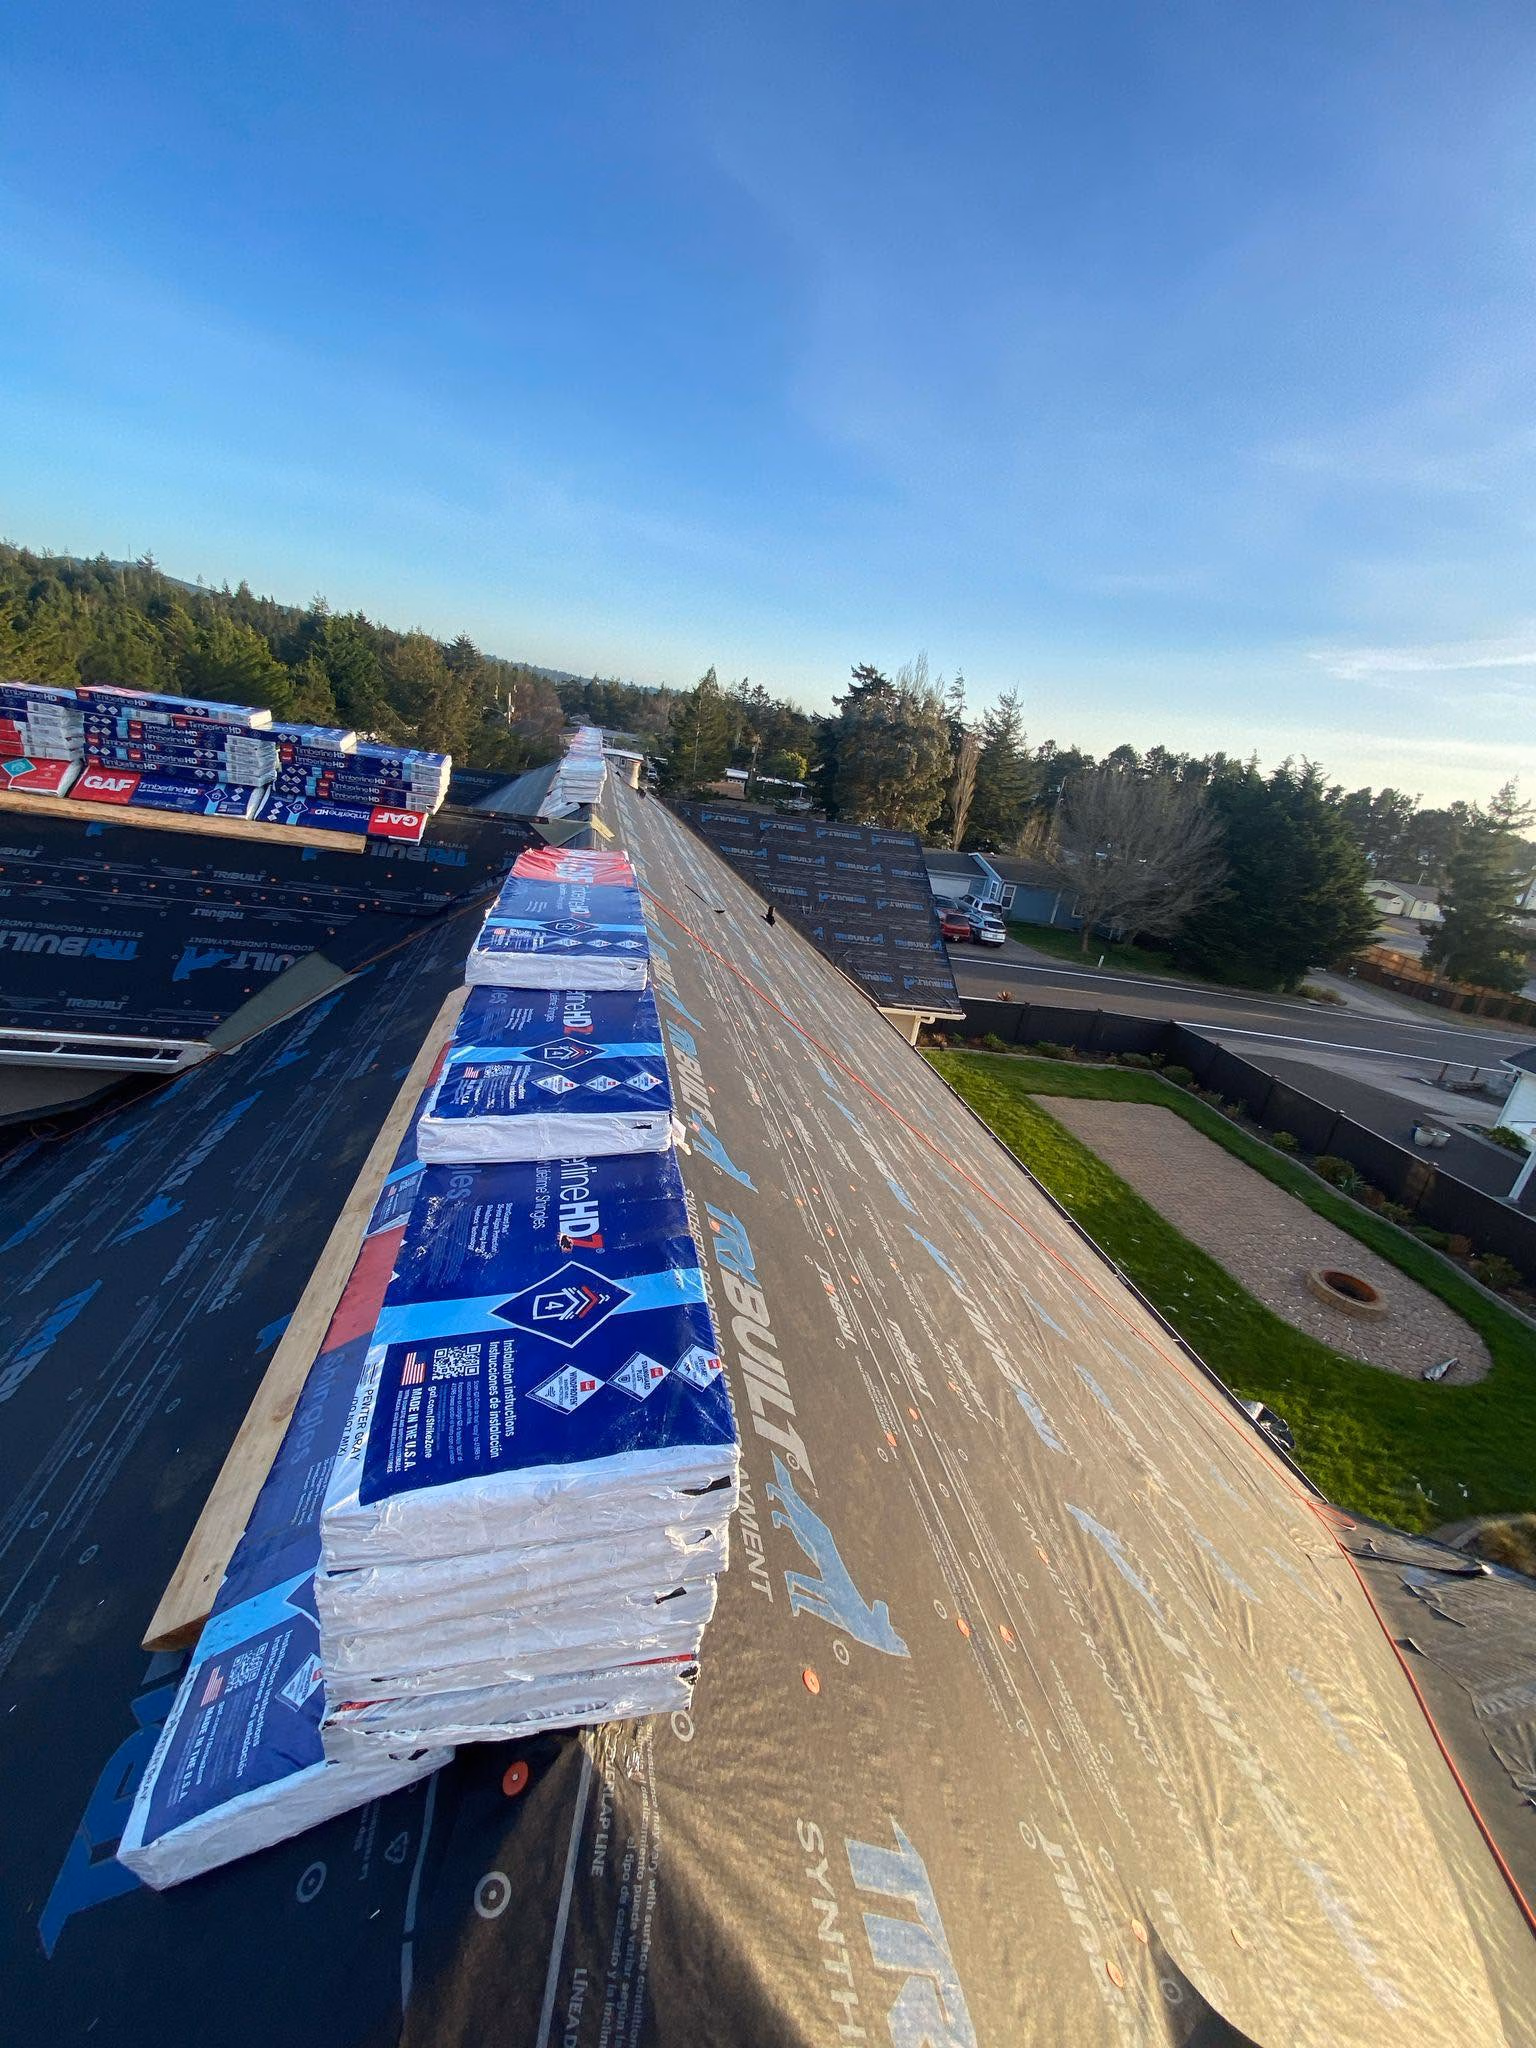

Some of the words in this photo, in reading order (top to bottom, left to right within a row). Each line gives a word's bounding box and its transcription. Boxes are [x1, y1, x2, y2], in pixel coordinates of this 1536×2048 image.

[84, 775, 135, 792] GAF
[375, 812, 419, 827] GAF
[529, 1195, 551, 1230] Shingles
[814, 1258, 859, 1345] TRIBULT
[488, 1342, 500, 1396] Instrucciones
[503, 1340, 515, 1385] Installation
[356, 1389, 374, 1430] PEWTER
[408, 1387, 422, 1412] MADE
[490, 1398, 501, 1408] de
[504, 1386, 516, 1436] instructions
[342, 1414, 354, 1433] NOT
[405, 1424, 416, 1440] THE
[407, 1414, 418, 1422] IN
[489, 1411, 502, 1458] instalación
[350, 1431, 365, 1461] GRAY
[404, 1441, 416, 1472] U.S.A.
[1081, 1632, 1159, 1766] ROOFING
[186, 1749, 199, 1770] THE
[652, 1812, 661, 1838] may
[590, 1833, 609, 1878] LINE
[649, 1838, 660, 1874] vary
[630, 1883, 645, 1931] puede
[646, 1875, 657, 1910] with
[611, 1907, 625, 1969] calzado
[638, 1911, 653, 1972] surface
[796, 1817, 868, 2048] SYNTH
[564, 1967, 588, 2030] LÍNEA
